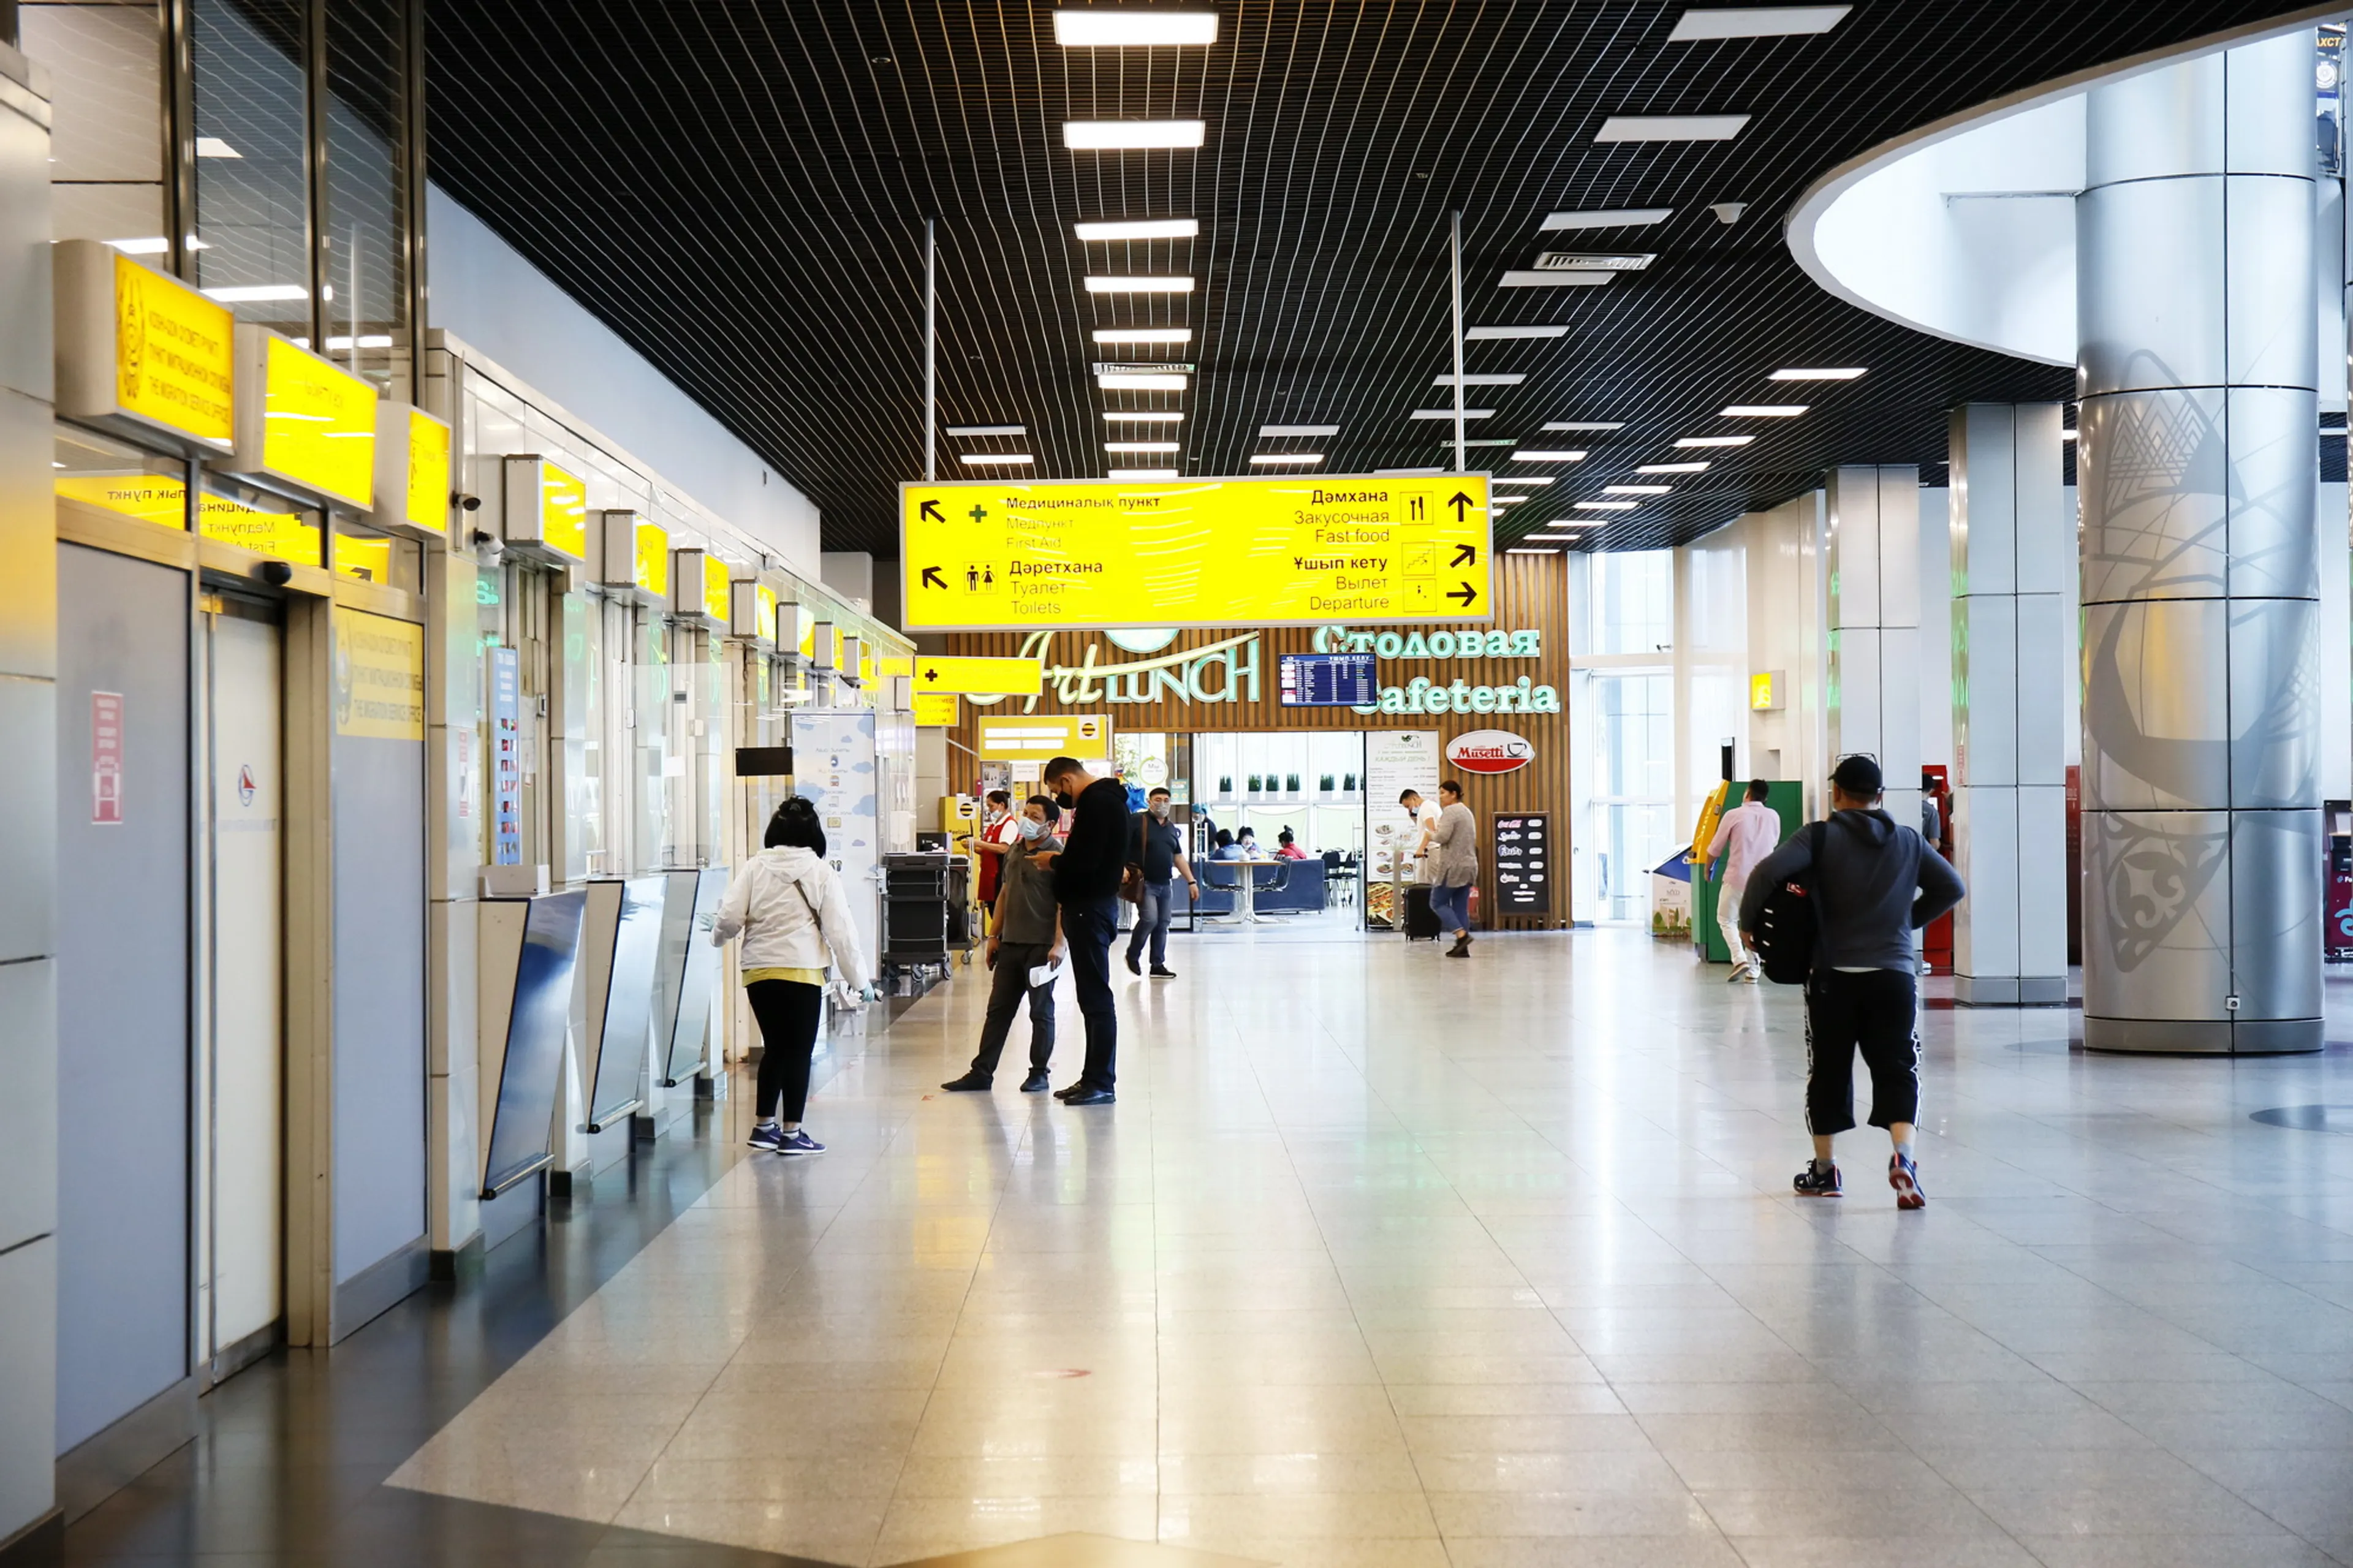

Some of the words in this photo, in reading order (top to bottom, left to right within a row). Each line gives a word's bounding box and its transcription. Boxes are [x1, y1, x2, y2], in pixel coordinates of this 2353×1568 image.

[1007, 498, 1114, 509] Медициналық
[1118, 498, 1161, 510] пункт
[1311, 490, 1389, 505] Дәмхана
[1007, 518, 1074, 531] Медпункт
[1294, 510, 1389, 527] Закусочная
[1007, 537, 1036, 548] First
[1040, 537, 1061, 548] Aid
[1316, 529, 1350, 543] Fast
[1354, 529, 1390, 542] food
[1009, 561, 1103, 576] Дәретхана
[1294, 557, 1344, 570] Ұшып
[1350, 558, 1389, 572] кету
[1010, 581, 1067, 598] Туалет
[1336, 576, 1389, 590] Вылет
[1011, 600, 1061, 614] Toilets
[1310, 596, 1390, 612] Departure
[1313, 625, 1539, 659] Столовая
[1457, 744, 1504, 758] Musetti
